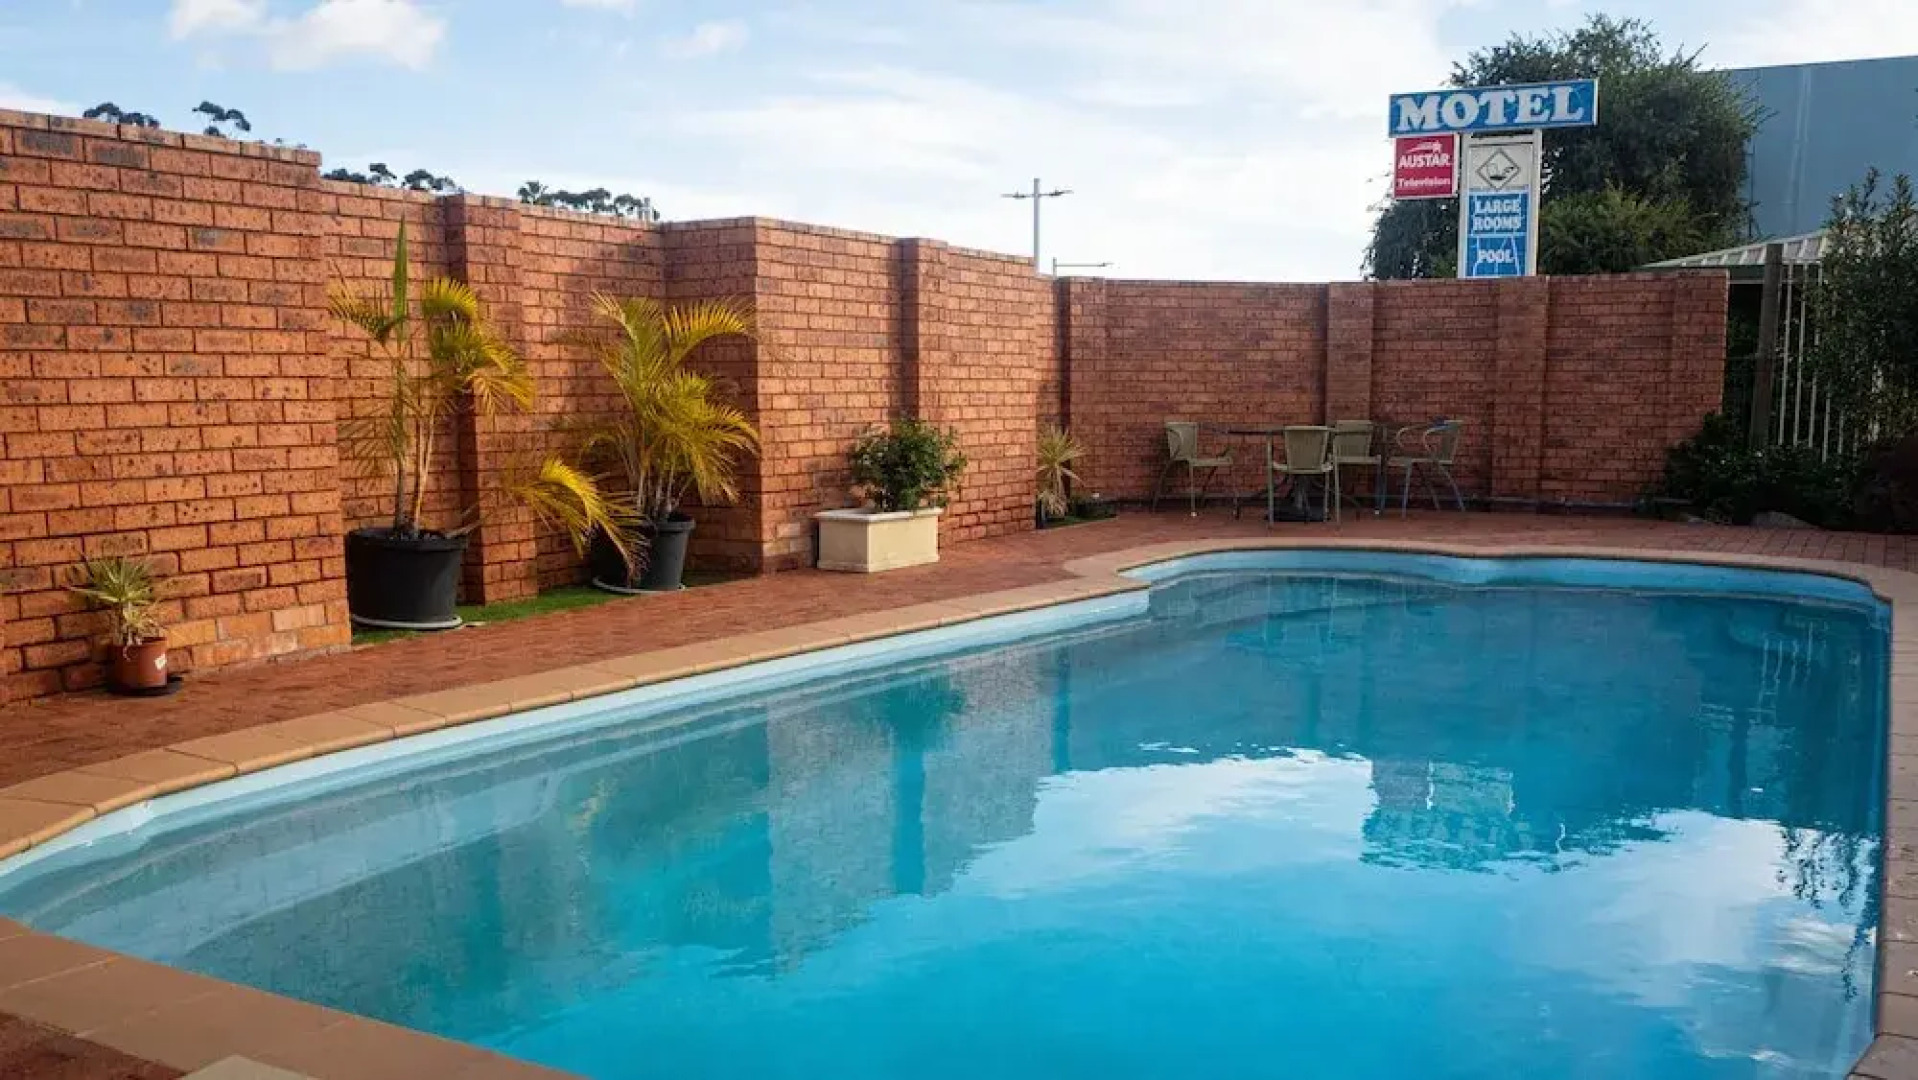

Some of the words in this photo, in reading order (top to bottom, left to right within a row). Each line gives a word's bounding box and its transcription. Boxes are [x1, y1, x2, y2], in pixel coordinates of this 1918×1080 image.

[1396, 86, 1583, 131] MOTEL
[1398, 153, 1450, 168] AUSTAR
[1398, 177, 1451, 190] Television
[1475, 200, 1521, 214] LARGE
[1473, 215, 1521, 230] ROOMS
[1477, 249, 1514, 264] POOL
